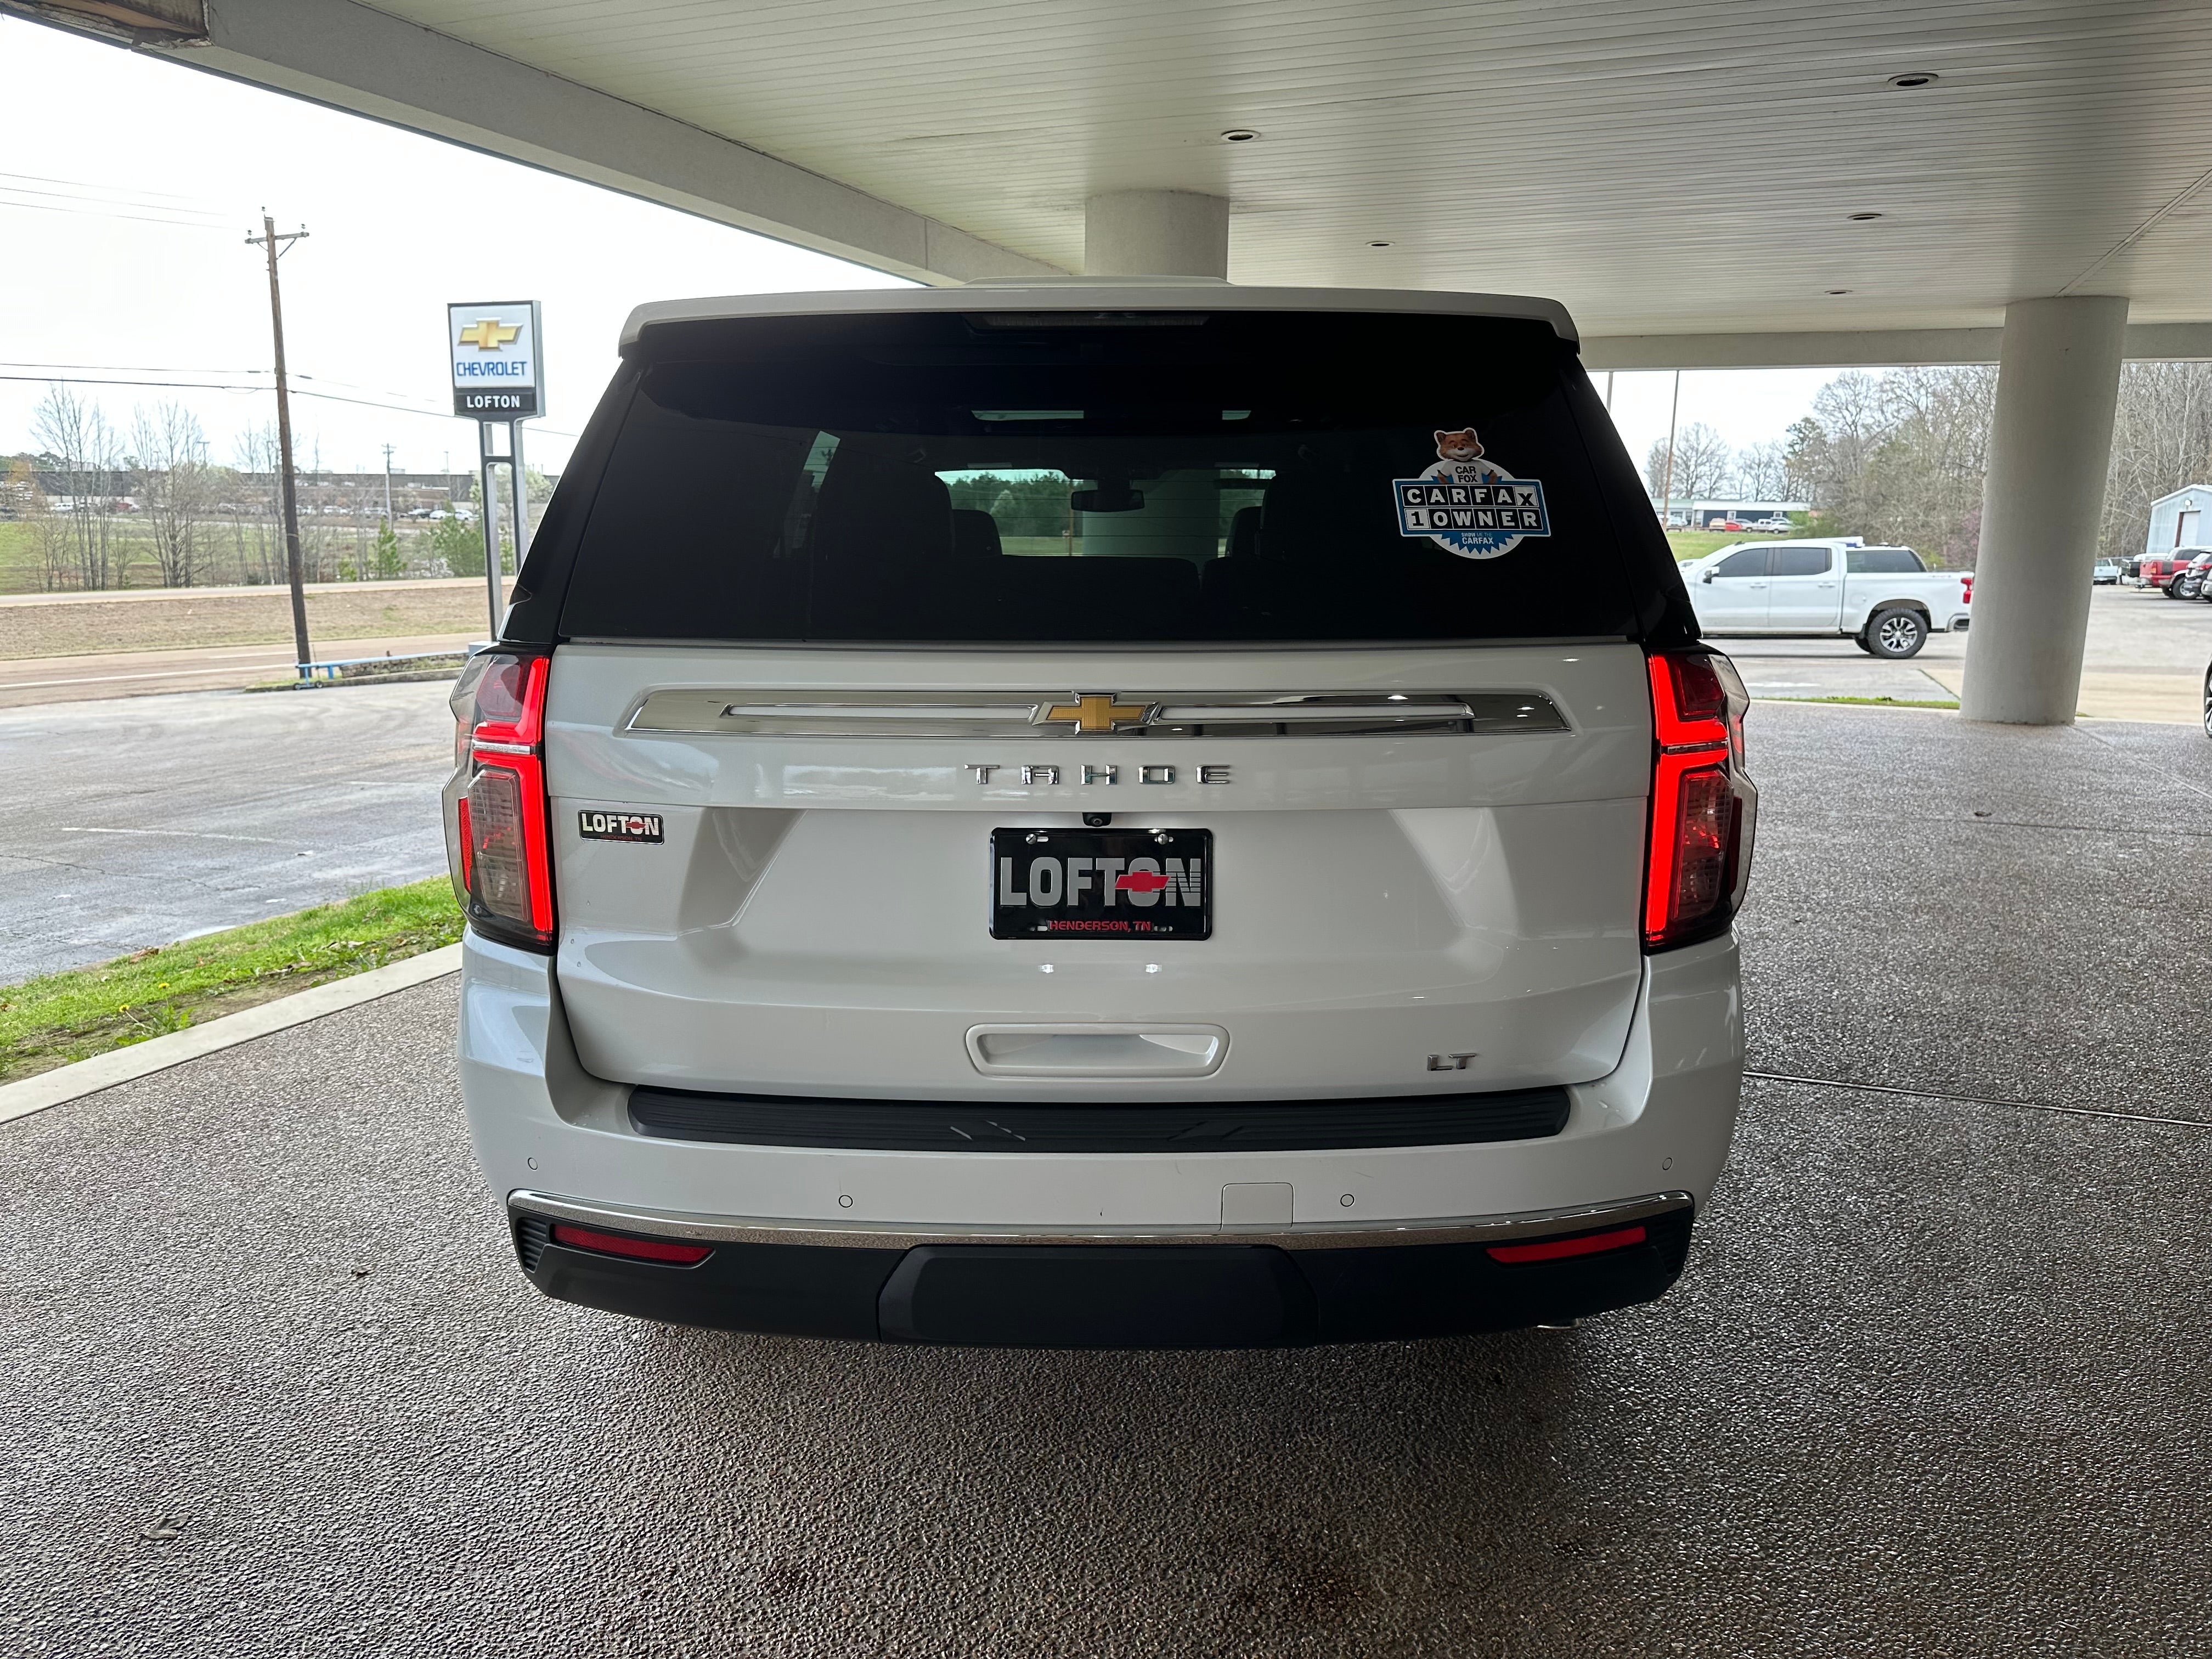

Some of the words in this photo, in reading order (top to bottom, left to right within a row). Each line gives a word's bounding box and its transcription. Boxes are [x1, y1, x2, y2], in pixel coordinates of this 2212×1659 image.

[456, 362, 527, 376] CHEVROLET
[466, 396, 520, 408] LOFTON
[1455, 466, 1476, 474] CAR
[1458, 475, 1478, 483] FOX
[1407, 488, 1535, 506] CARFAX
[1410, 511, 1424, 527] 1
[1433, 511, 1538, 527] OWNER
[964, 764, 1230, 785] TAHOE
[582, 813, 659, 836] LOFTON
[1000, 857, 1201, 907] LOFTON
[1049, 920, 1131, 932] HENDERSON,
[1133, 921, 1151, 931] TN
[1427, 1053, 1476, 1071] LT
